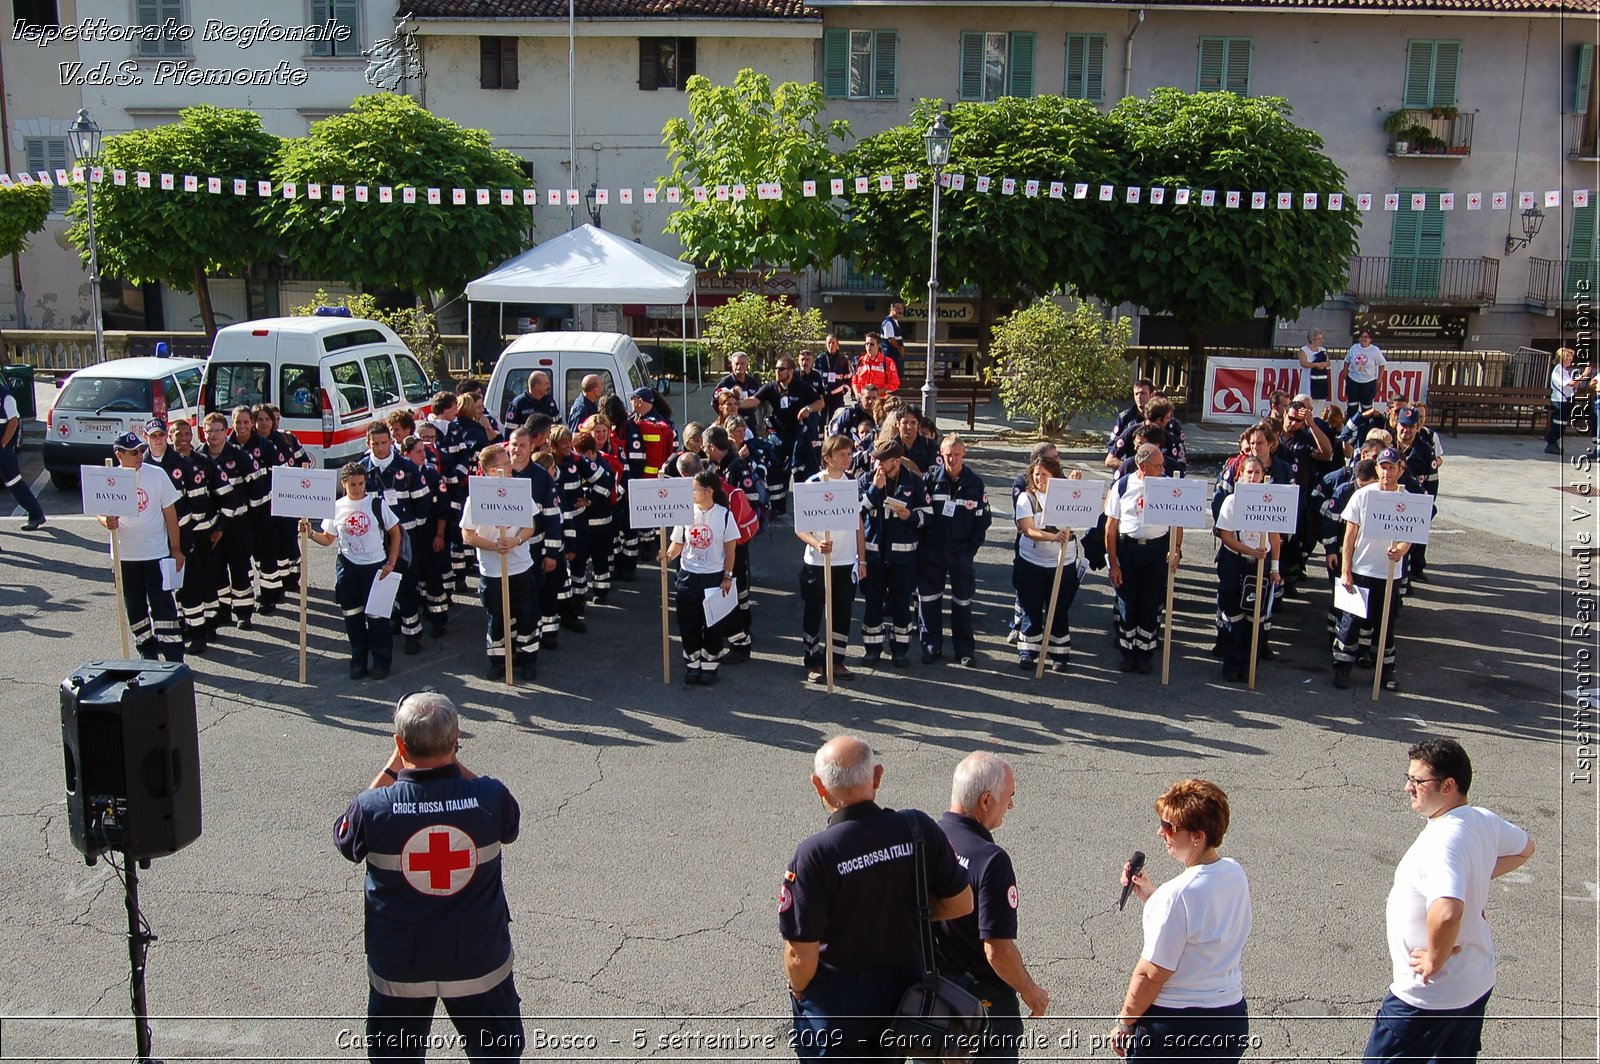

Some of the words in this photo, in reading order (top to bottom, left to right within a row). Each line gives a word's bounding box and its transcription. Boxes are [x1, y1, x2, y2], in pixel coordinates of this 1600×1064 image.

[1388, 314, 1441, 327] QUARK
[95, 492, 128, 501] BAVENO
[278, 492, 331, 502] BORGOMANERO
[480, 503, 524, 512] CHIVASSO
[636, 503, 690, 512] GRAVELLONA
[803, 507, 855, 517] MONCALVO
[1055, 504, 1093, 513] OLEGGIO
[1148, 502, 1203, 513] SAVIGLIANO
[1246, 504, 1287, 513] SETTIMO
[653, 512, 674, 520] TOCE
[1244, 513, 1288, 523] TORINESE
[1372, 512, 1426, 525] VILLANOVA
[1384, 523, 1415, 533] D'ASTI
[392, 802, 417, 815] CROCE
[418, 801, 444, 814] ROSSA
[445, 797, 480, 812] ITALIANA
[837, 856, 864, 876] CROCE
[863, 848, 891, 868] ROSSA
